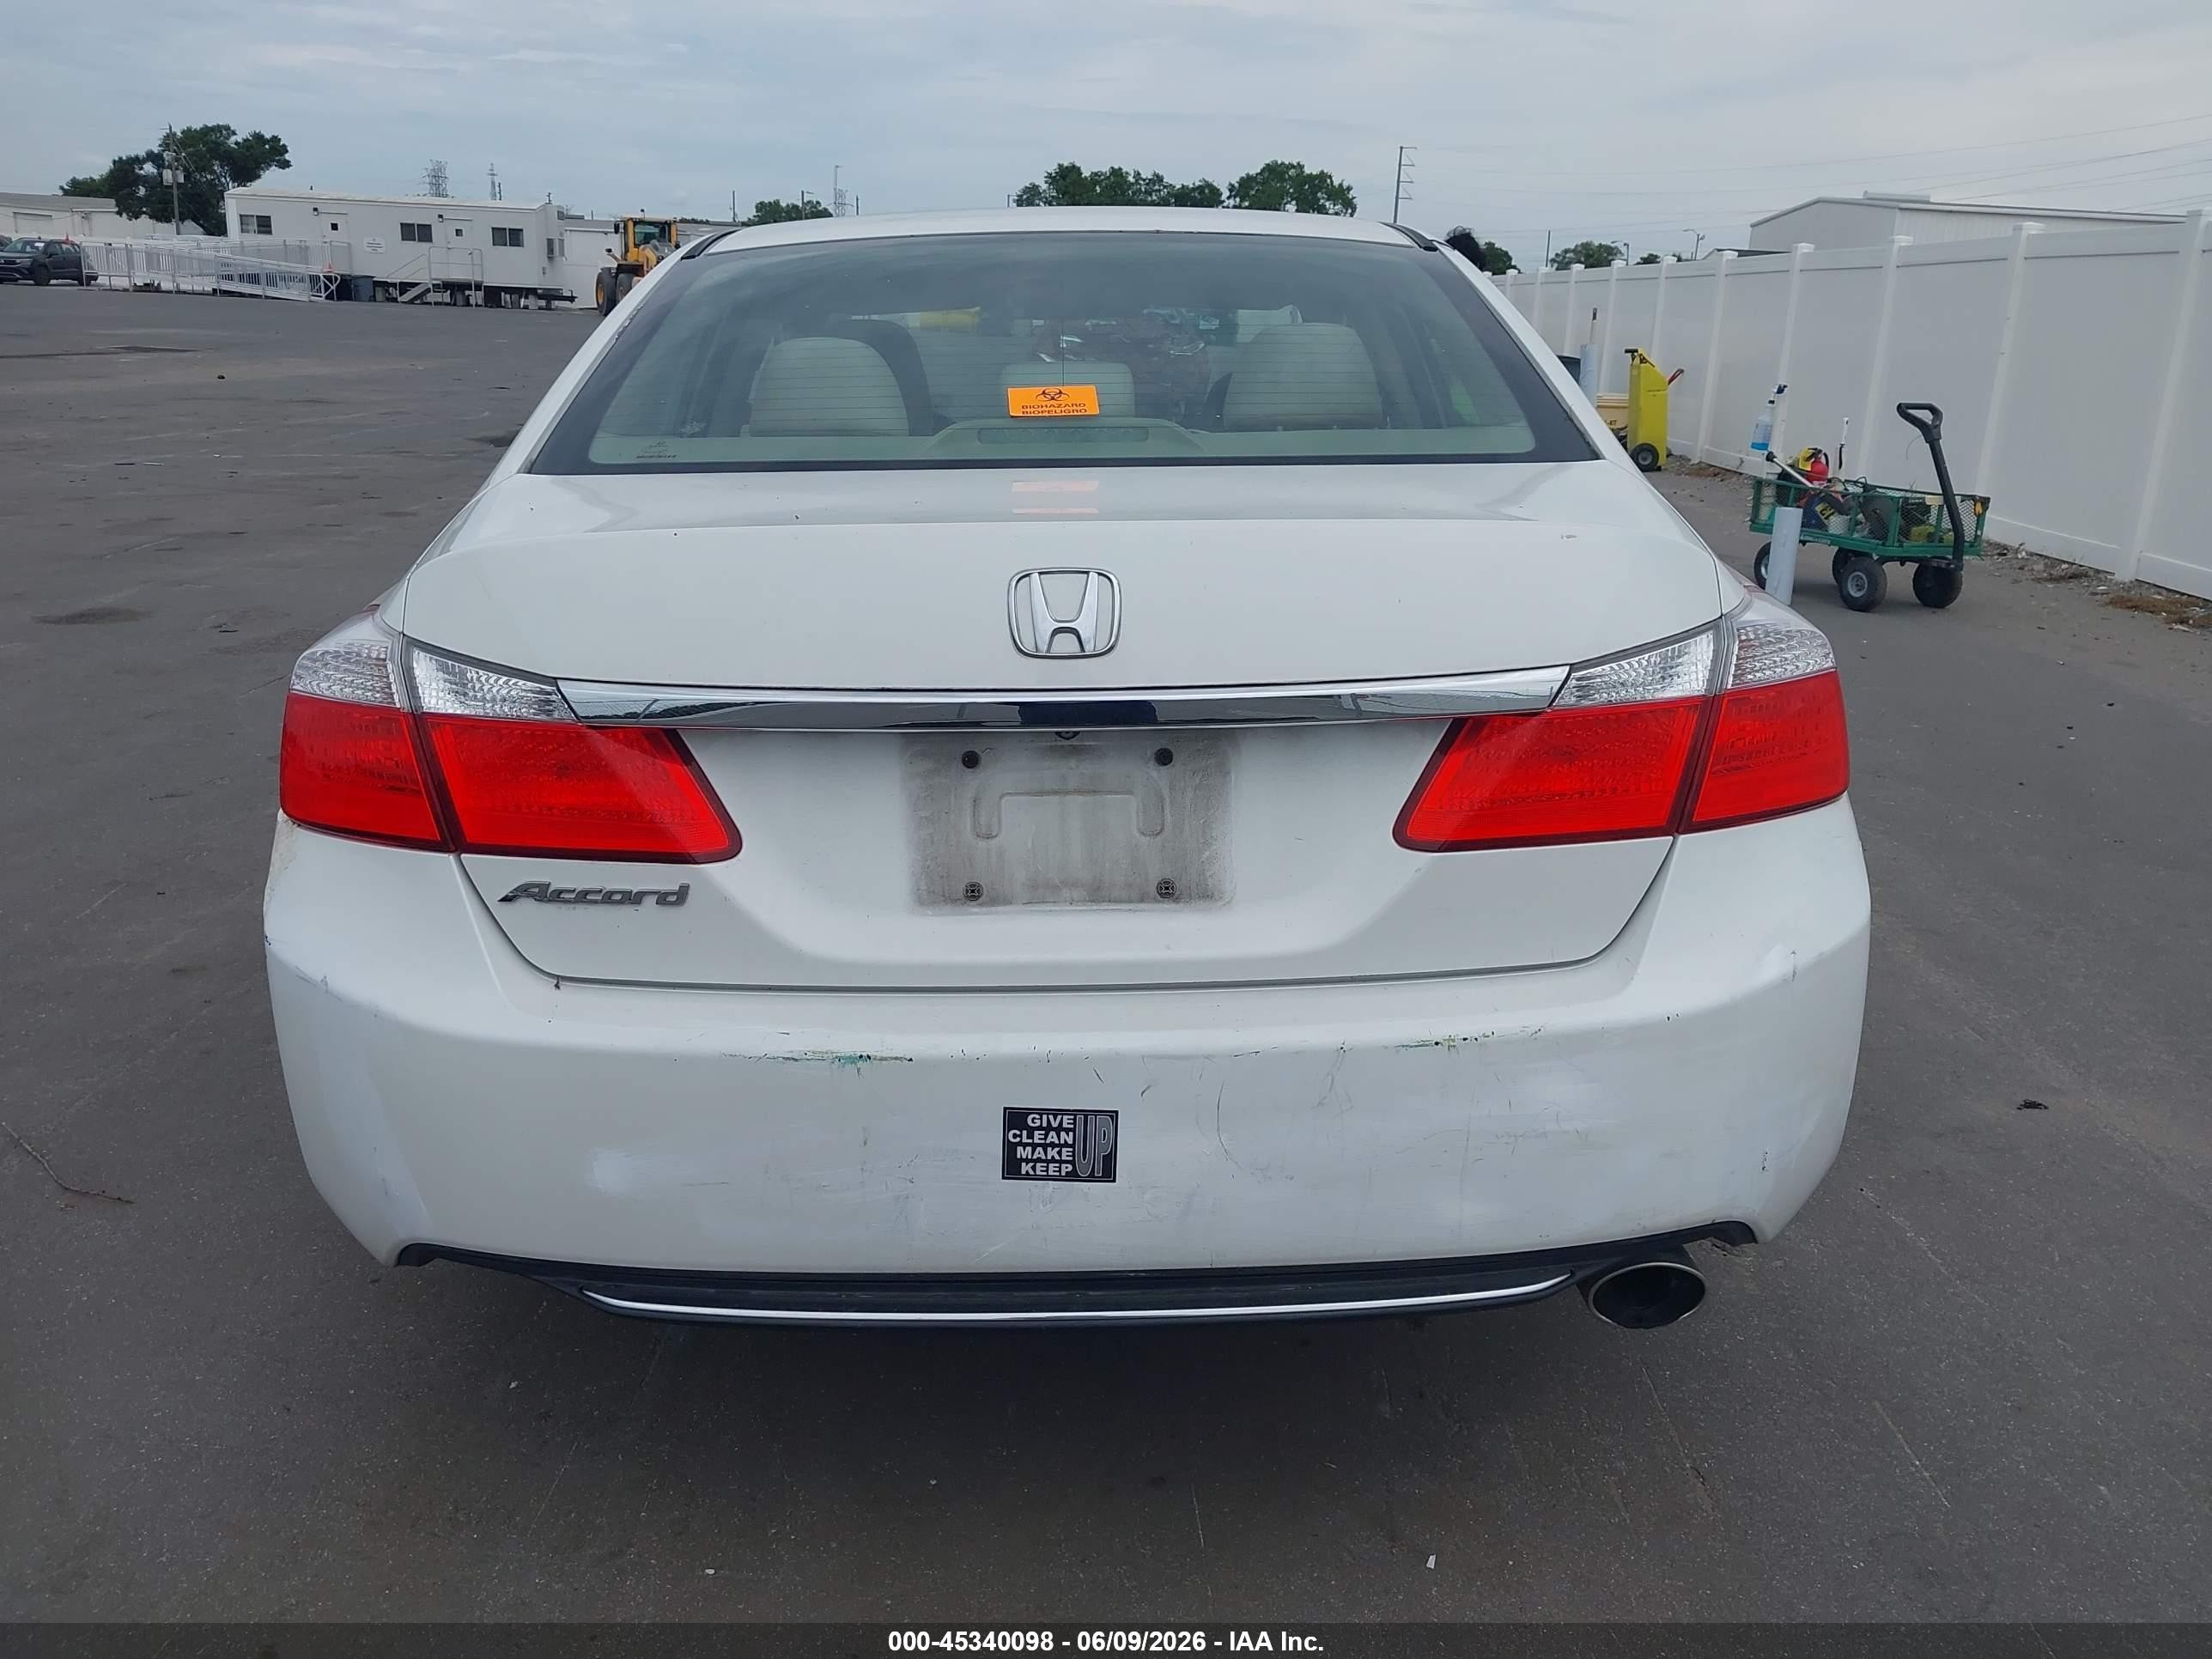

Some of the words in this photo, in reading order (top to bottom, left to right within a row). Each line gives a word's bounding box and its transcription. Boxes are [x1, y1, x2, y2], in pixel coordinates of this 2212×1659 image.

[498, 880, 690, 906] Accord
[1027, 1114, 1074, 1128] GIVE
[1007, 1129, 1073, 1145] CLEAN
[1016, 1146, 1073, 1161] MAKE
[1075, 1115, 1114, 1177] UP
[1020, 1162, 1073, 1176] KEEP
